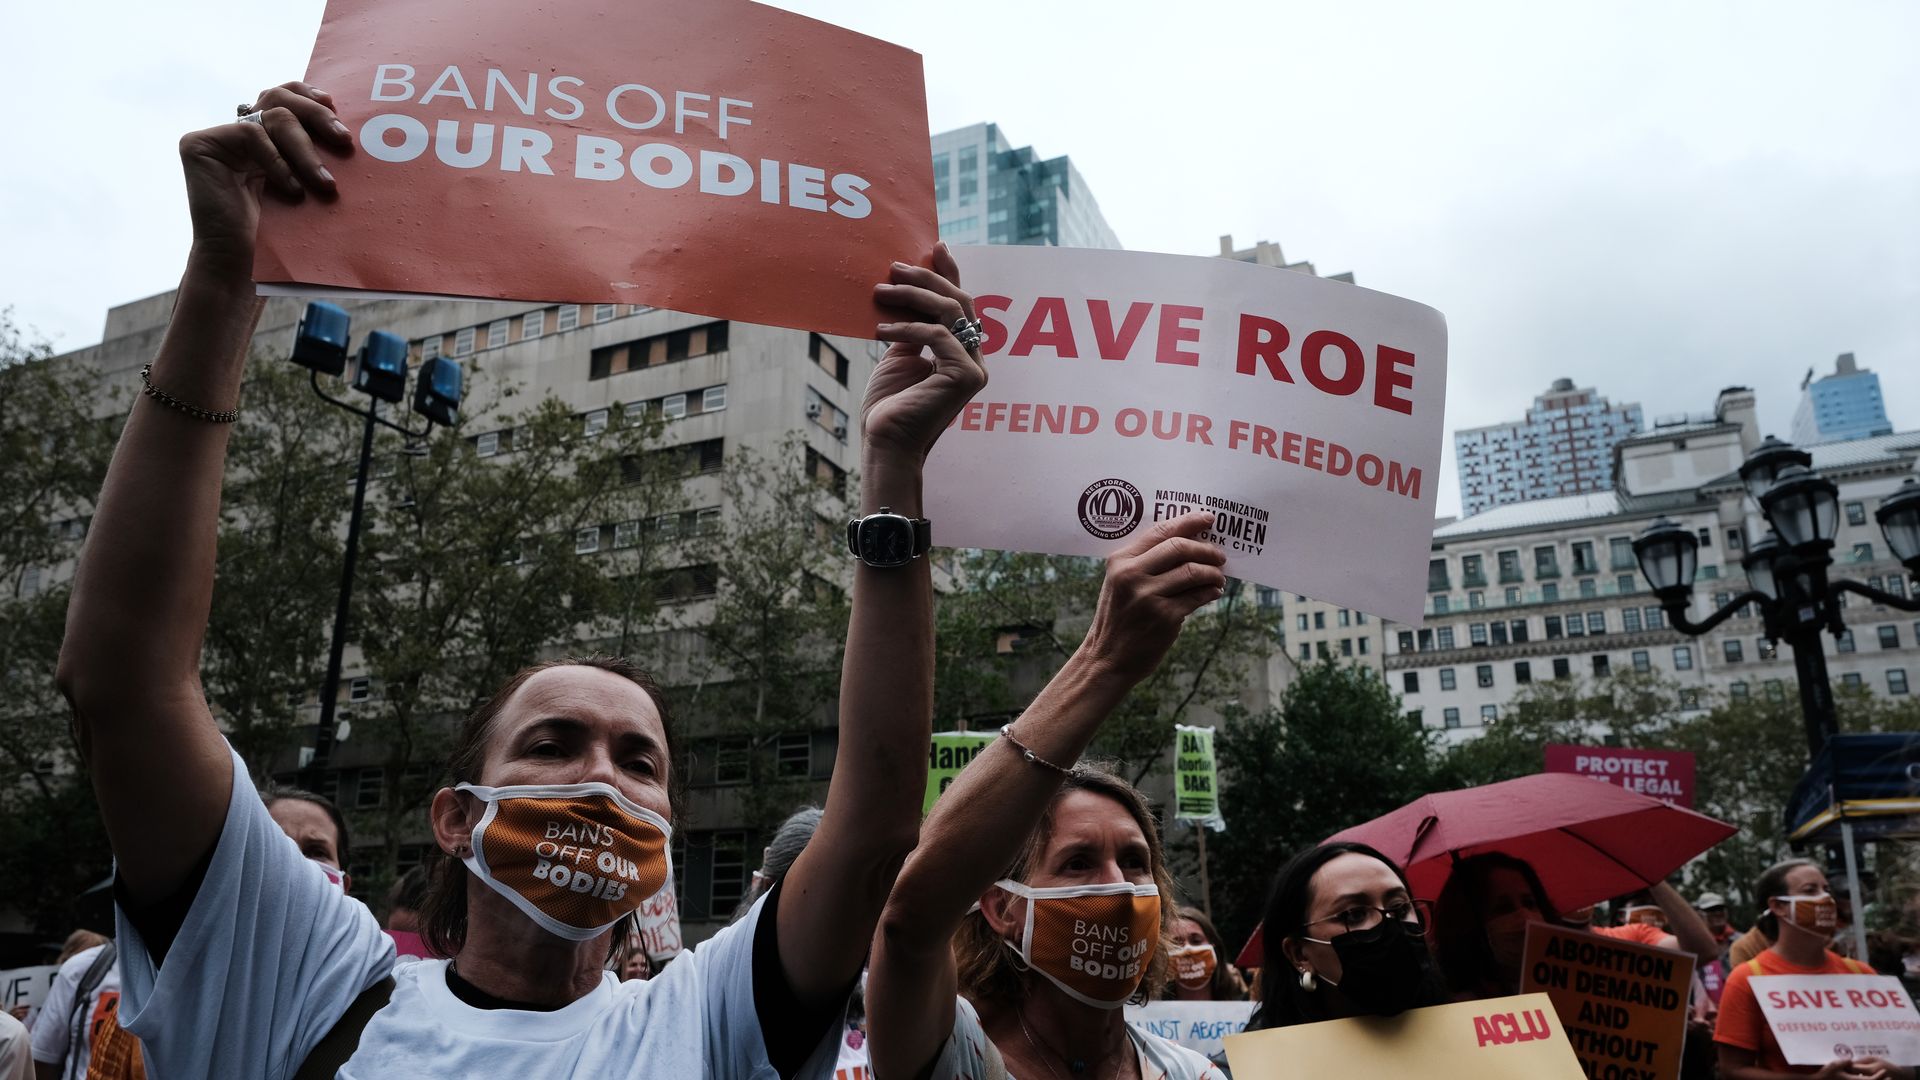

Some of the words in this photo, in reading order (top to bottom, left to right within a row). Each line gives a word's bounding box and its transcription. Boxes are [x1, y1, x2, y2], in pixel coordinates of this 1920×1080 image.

[369, 63, 585, 121] BANS
[605, 82, 754, 140] OFF
[358, 113, 555, 176] OUR
[574, 134, 873, 220] BODIES
[972, 294, 1204, 367] SAVE
[1235, 313, 1416, 416] ROE
[946, 402, 1099, 435] EFEND
[1114, 406, 1214, 447] OUR
[1228, 419, 1423, 500] FREEDOM
[1085, 482, 1102, 497] NEW
[1103, 479, 1125, 488] YORK
[1125, 484, 1140, 498] CITY
[1089, 488, 1133, 517] NOW
[1155, 489, 1203, 505] NATIONAL
[1205, 495, 1270, 522] ORGANIZATION
[1081, 517, 1109, 538] FOUNDING
[1110, 520, 1138, 538] CHAPTER
[1194, 531, 1226, 546] ORK
[1232, 540, 1263, 556] CITY
[1575, 755, 1669, 776] PROTECT
[1622, 777, 1683, 796] LEGAL
[545, 821, 615, 847] BANS
[535, 841, 592, 866] OFF
[596, 851, 640, 881] OUR
[532, 858, 629, 902] BODIES
[1073, 919, 1129, 943] BANS
[1071, 938, 1114, 960] OFF
[1117, 938, 1148, 961] OUR
[1545, 936, 1674, 982] ABORTION
[1069, 954, 1141, 980] BODIES
[1533, 962, 1569, 990] ON
[1575, 971, 1679, 1011] DEMAND
[1767, 989, 1843, 1009] SAVE
[1847, 989, 1906, 1009] ROE
[1473, 1009, 1552, 1048] ACLU
[1578, 1001, 1630, 1030] AND
[1777, 1021, 1827, 1033] DEFEND
[1831, 1021, 1858, 1033] OUR
[1565, 1026, 1659, 1065] THOUT
